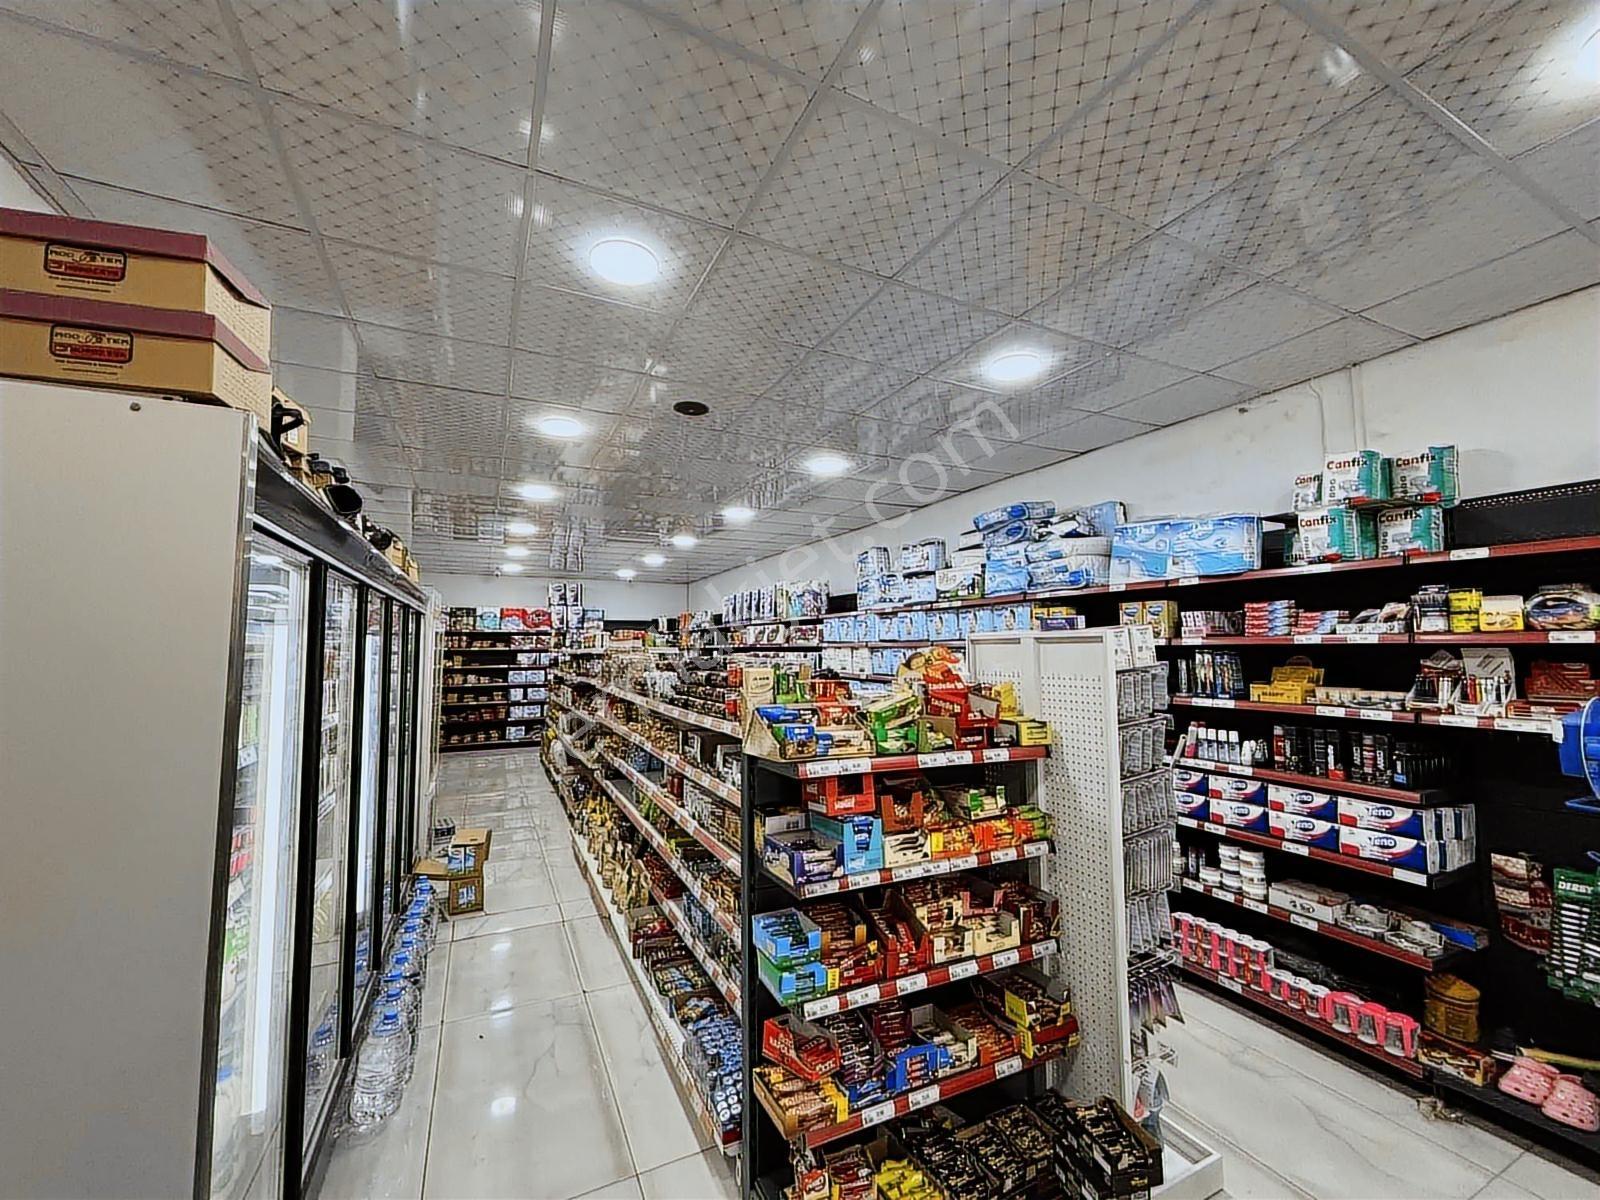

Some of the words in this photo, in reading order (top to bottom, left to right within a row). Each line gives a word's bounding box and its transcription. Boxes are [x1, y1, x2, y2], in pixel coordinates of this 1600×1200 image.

[1326, 457, 1368, 471] Canfix
[1395, 452, 1436, 468] Canfix
[1299, 513, 1337, 529] Canfix
[1379, 507, 1423, 524] Canfix
[1557, 880, 1594, 894] DERBY
